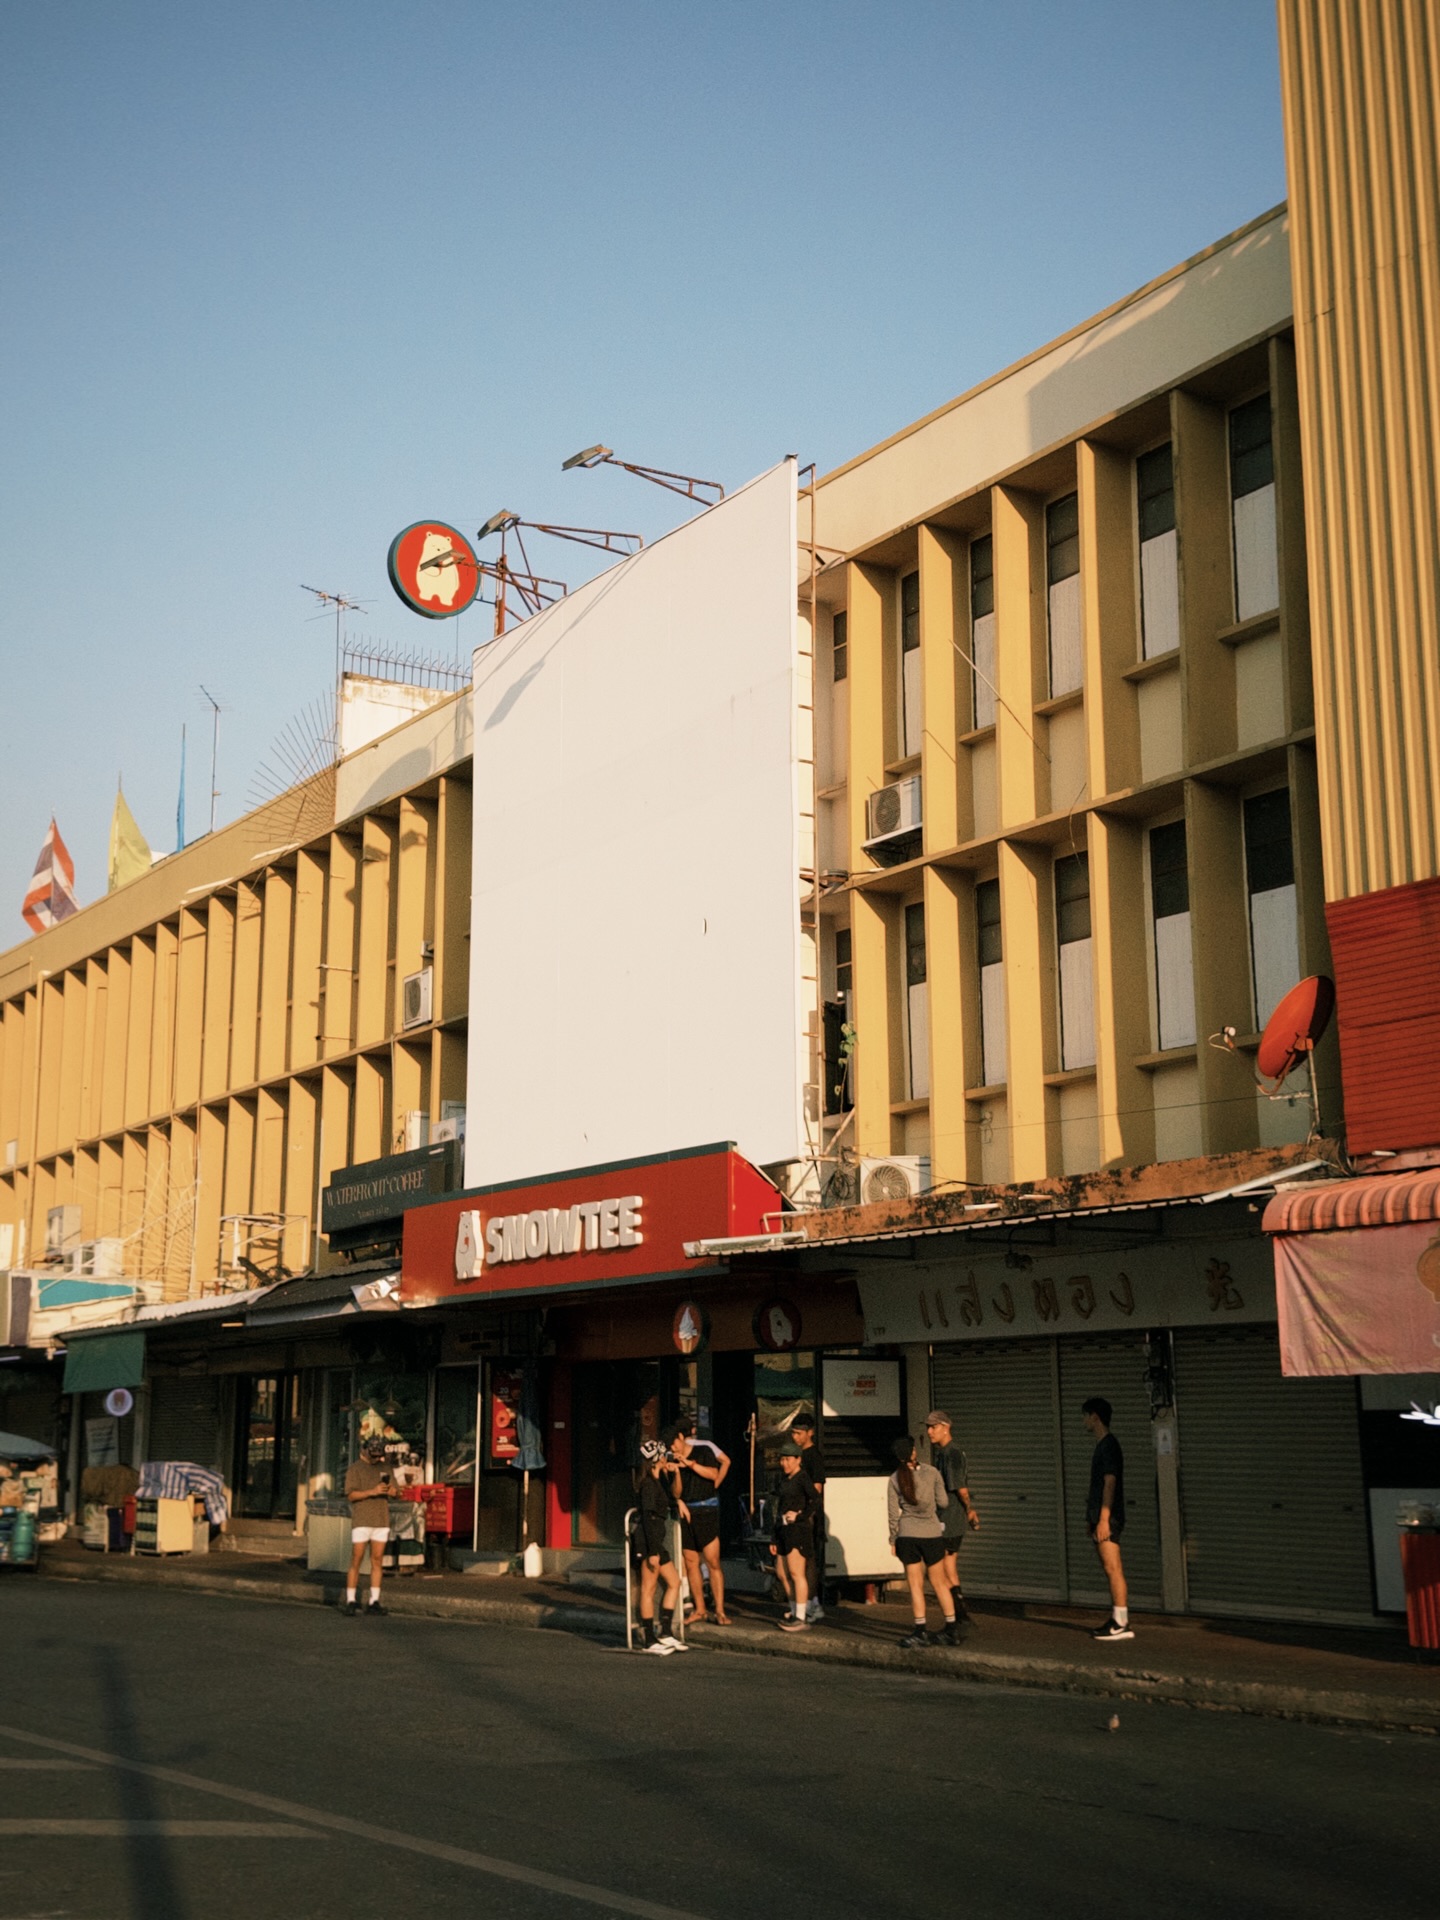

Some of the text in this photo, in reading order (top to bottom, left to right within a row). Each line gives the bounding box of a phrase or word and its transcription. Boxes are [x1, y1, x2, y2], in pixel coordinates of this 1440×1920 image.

[388, 1168, 426, 1194] COFFEE
[486, 1195, 643, 1265] SNOWTEE
[918, 1269, 1136, 1330] แสงทอง
